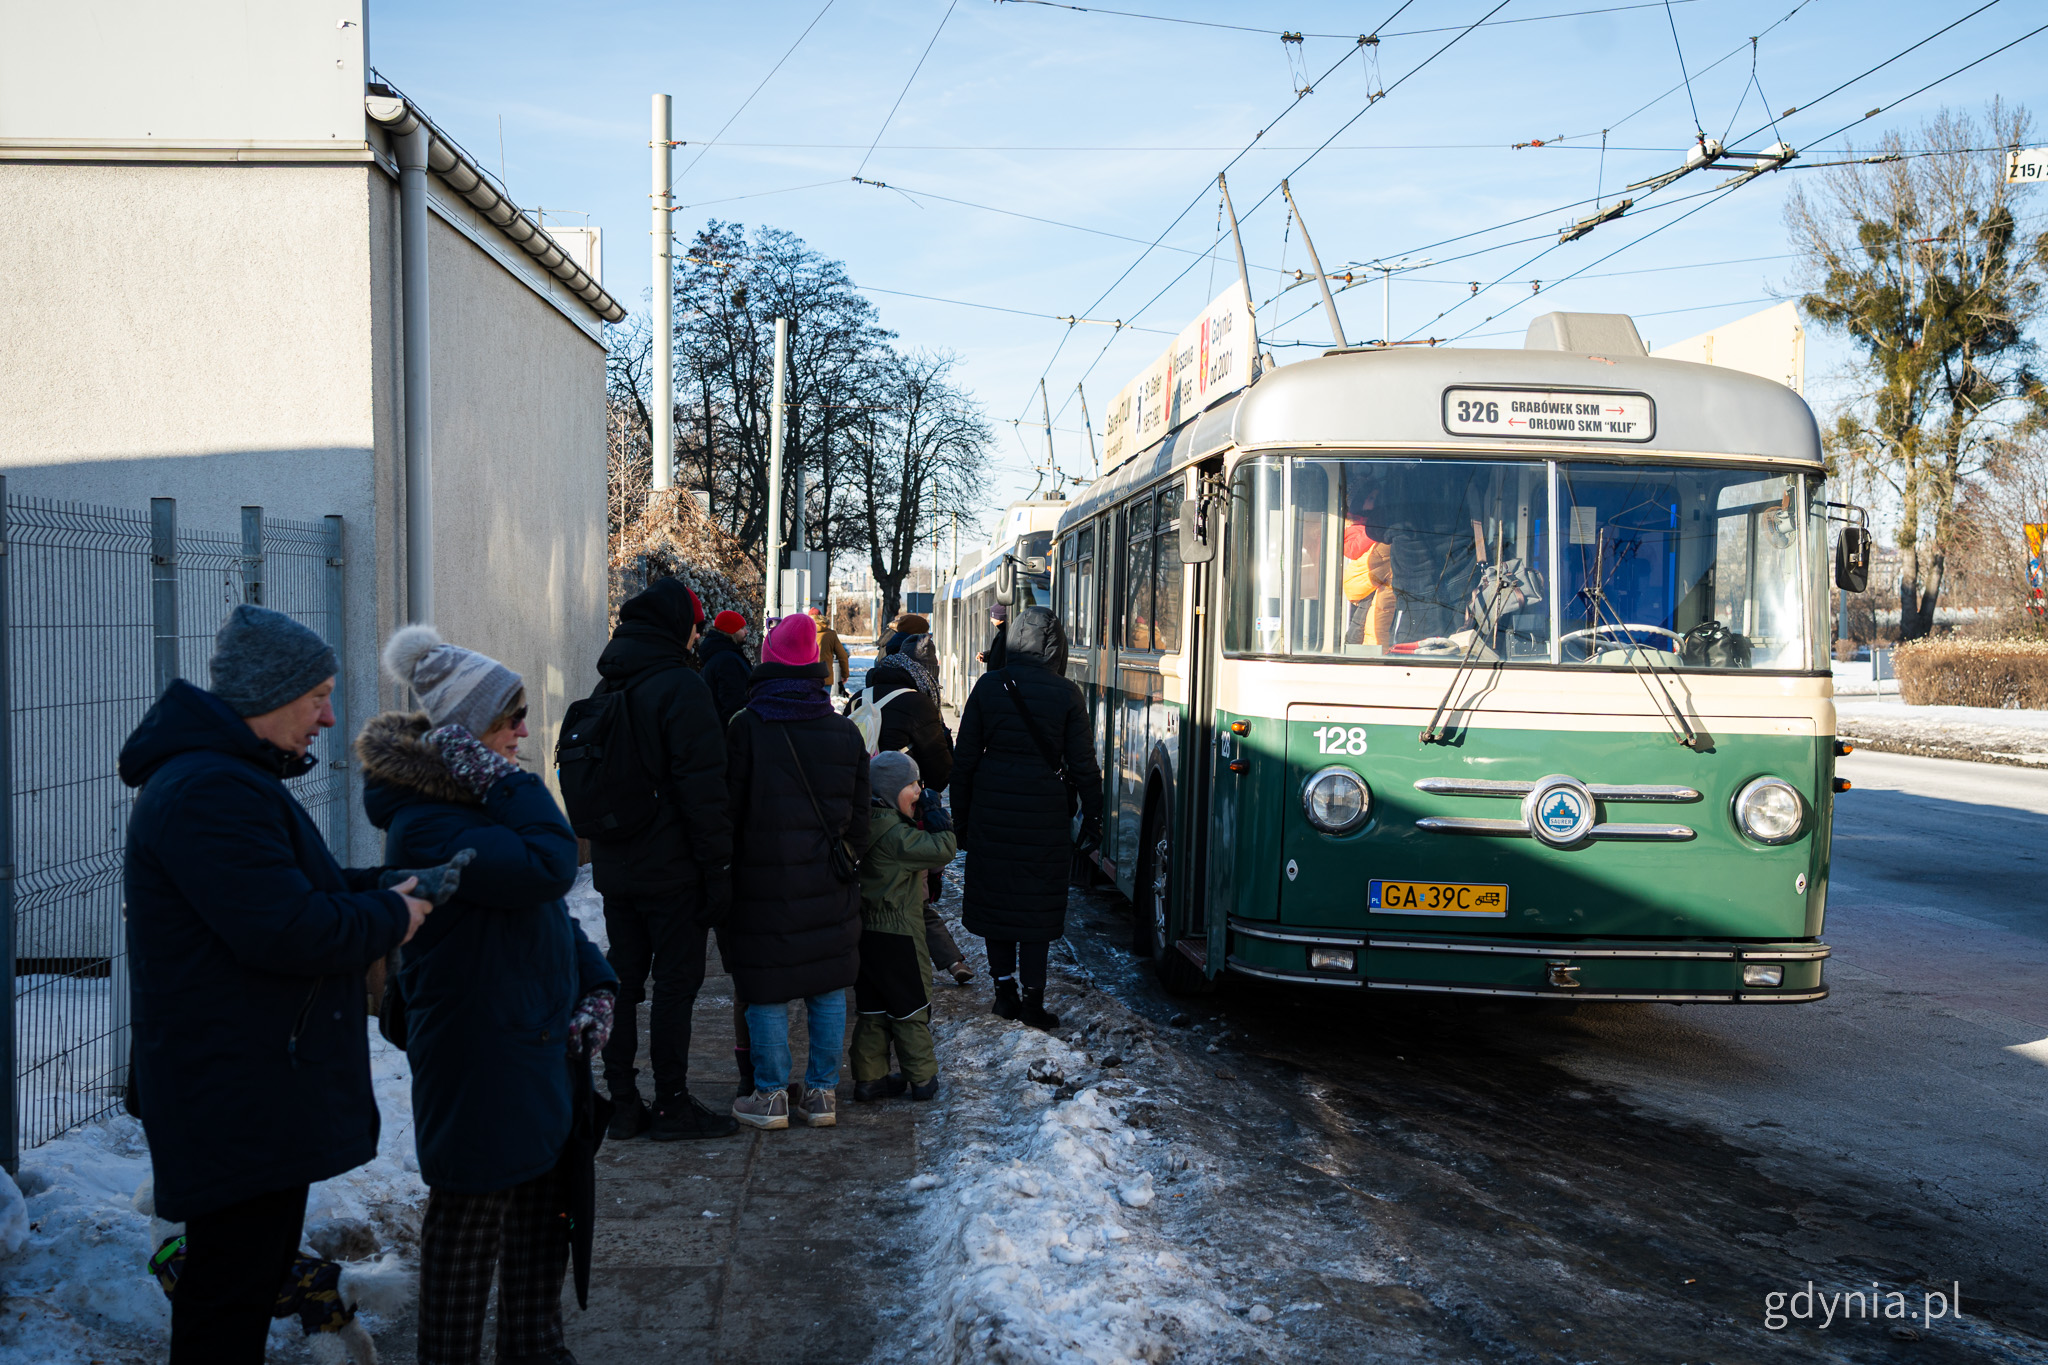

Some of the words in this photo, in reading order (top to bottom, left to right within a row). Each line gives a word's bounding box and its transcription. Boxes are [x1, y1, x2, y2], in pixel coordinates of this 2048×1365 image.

[2010, 163, 2048, 179] Z15/
[1458, 400, 1499, 423] 326
[1511, 400, 1573, 415] GRABÓWEK
[1575, 404, 1600, 416] SKM
[1529, 418, 1575, 431] ORŁOWO
[1578, 420, 1602, 432] SKM
[1313, 726, 1367, 756] 128
[1385, 885, 1417, 907] GA
[1428, 886, 1471, 909] 39C
